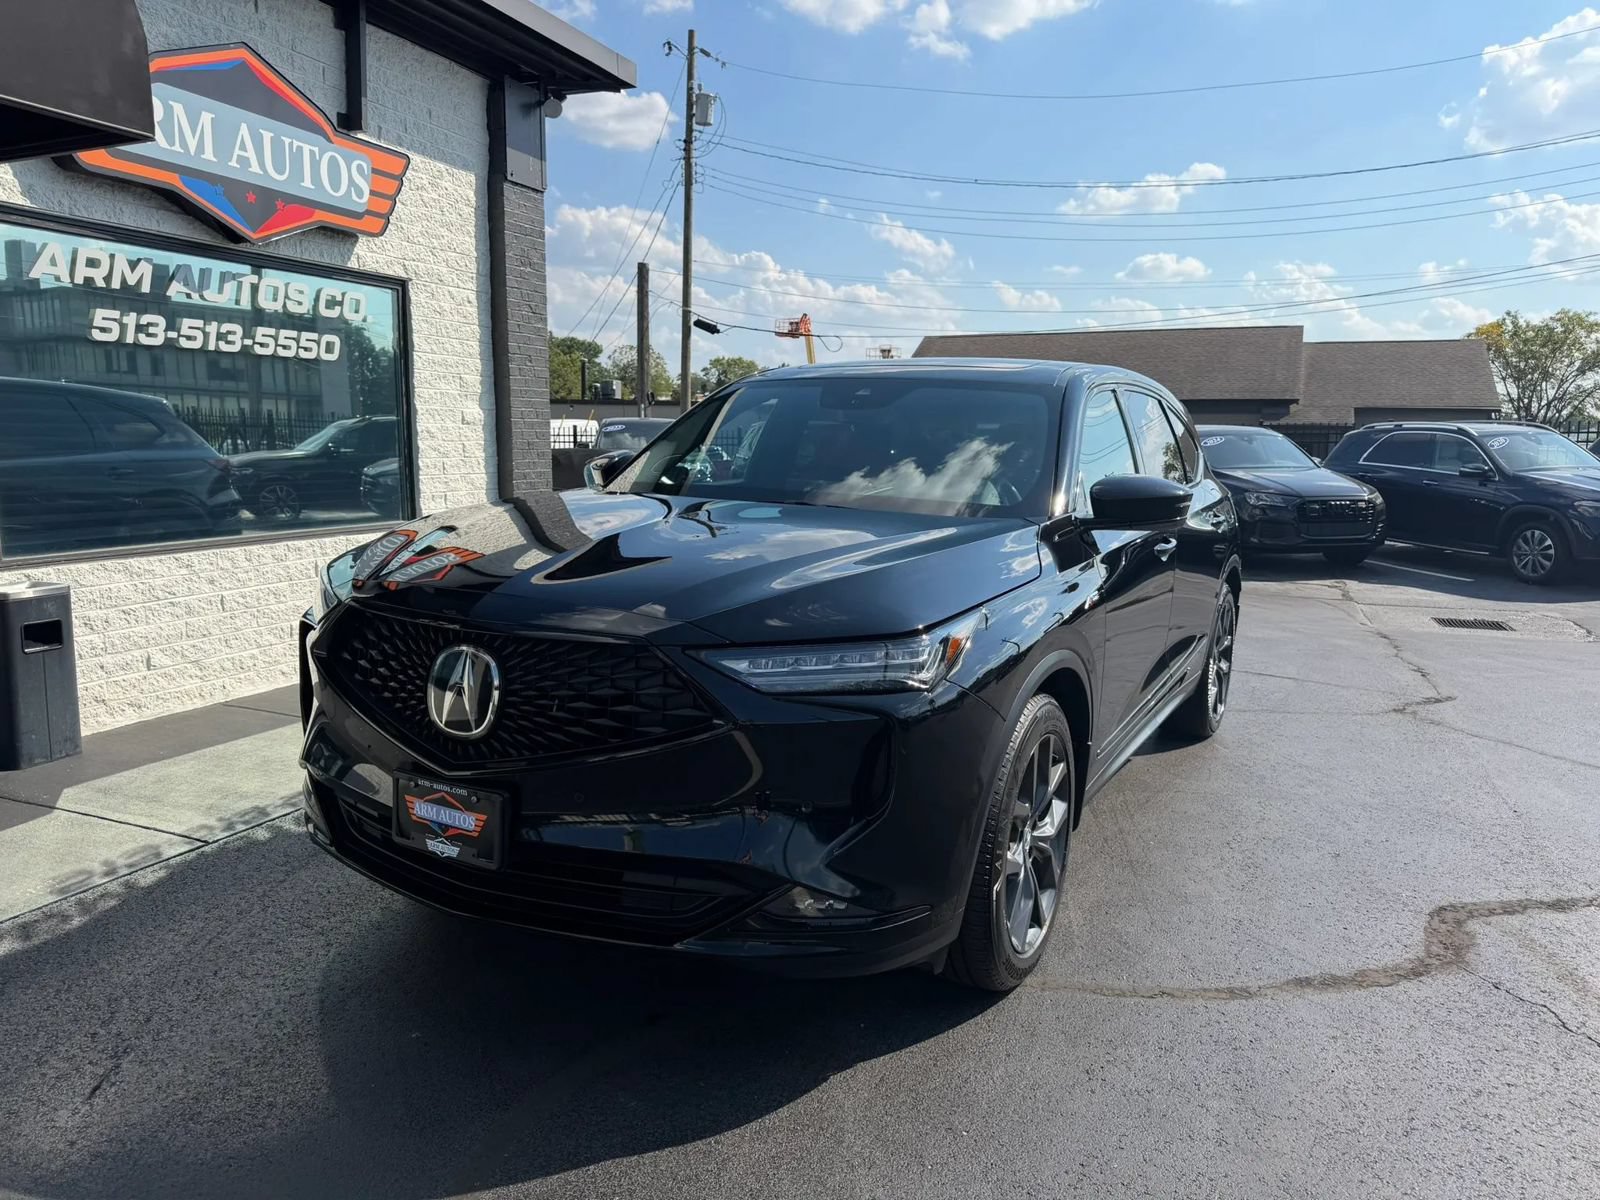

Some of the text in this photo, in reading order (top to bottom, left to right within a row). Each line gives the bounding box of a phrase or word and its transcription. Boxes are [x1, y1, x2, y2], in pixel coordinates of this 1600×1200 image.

[152, 95, 369, 204] RM AUTOS
[28, 242, 154, 294] ARM
[166, 263, 311, 315] AUTOS
[91, 308, 341, 362] 513-513-5550
[415, 801, 475, 829] ARM AUTOS
